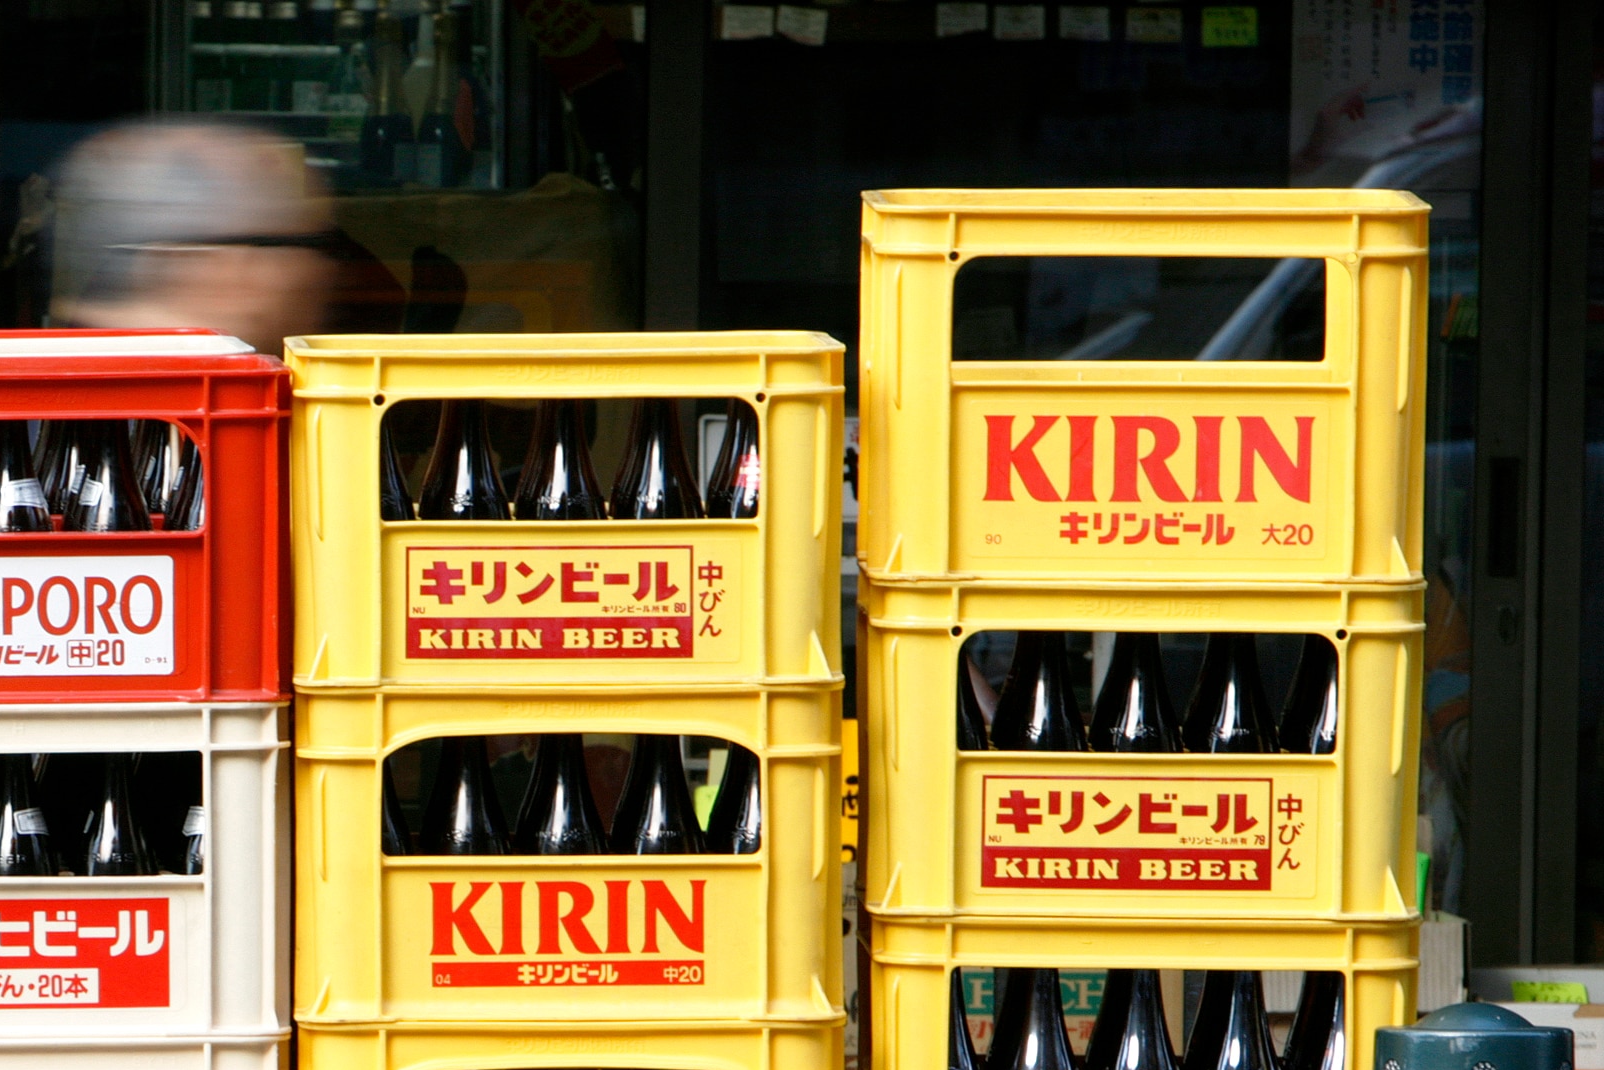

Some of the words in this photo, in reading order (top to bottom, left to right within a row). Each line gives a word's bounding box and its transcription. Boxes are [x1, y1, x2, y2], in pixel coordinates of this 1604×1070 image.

[982, 415, 1316, 503] KIRIN
[985, 534, 1002, 545] 90
[1059, 511, 1234, 545] キリンビール
[419, 561, 680, 605] キリンビール
[698, 560, 725, 638] 中びん
[419, 628, 542, 650] KIRIN
[562, 627, 681, 648] BEER
[996, 790, 1259, 835] キリンビール
[1277, 793, 1304, 871] 中びん
[994, 857, 1120, 880] KIRIN
[1139, 858, 1259, 881] BEER
[429, 879, 707, 956] KIRIN
[517, 962, 619, 985] キリンビール
